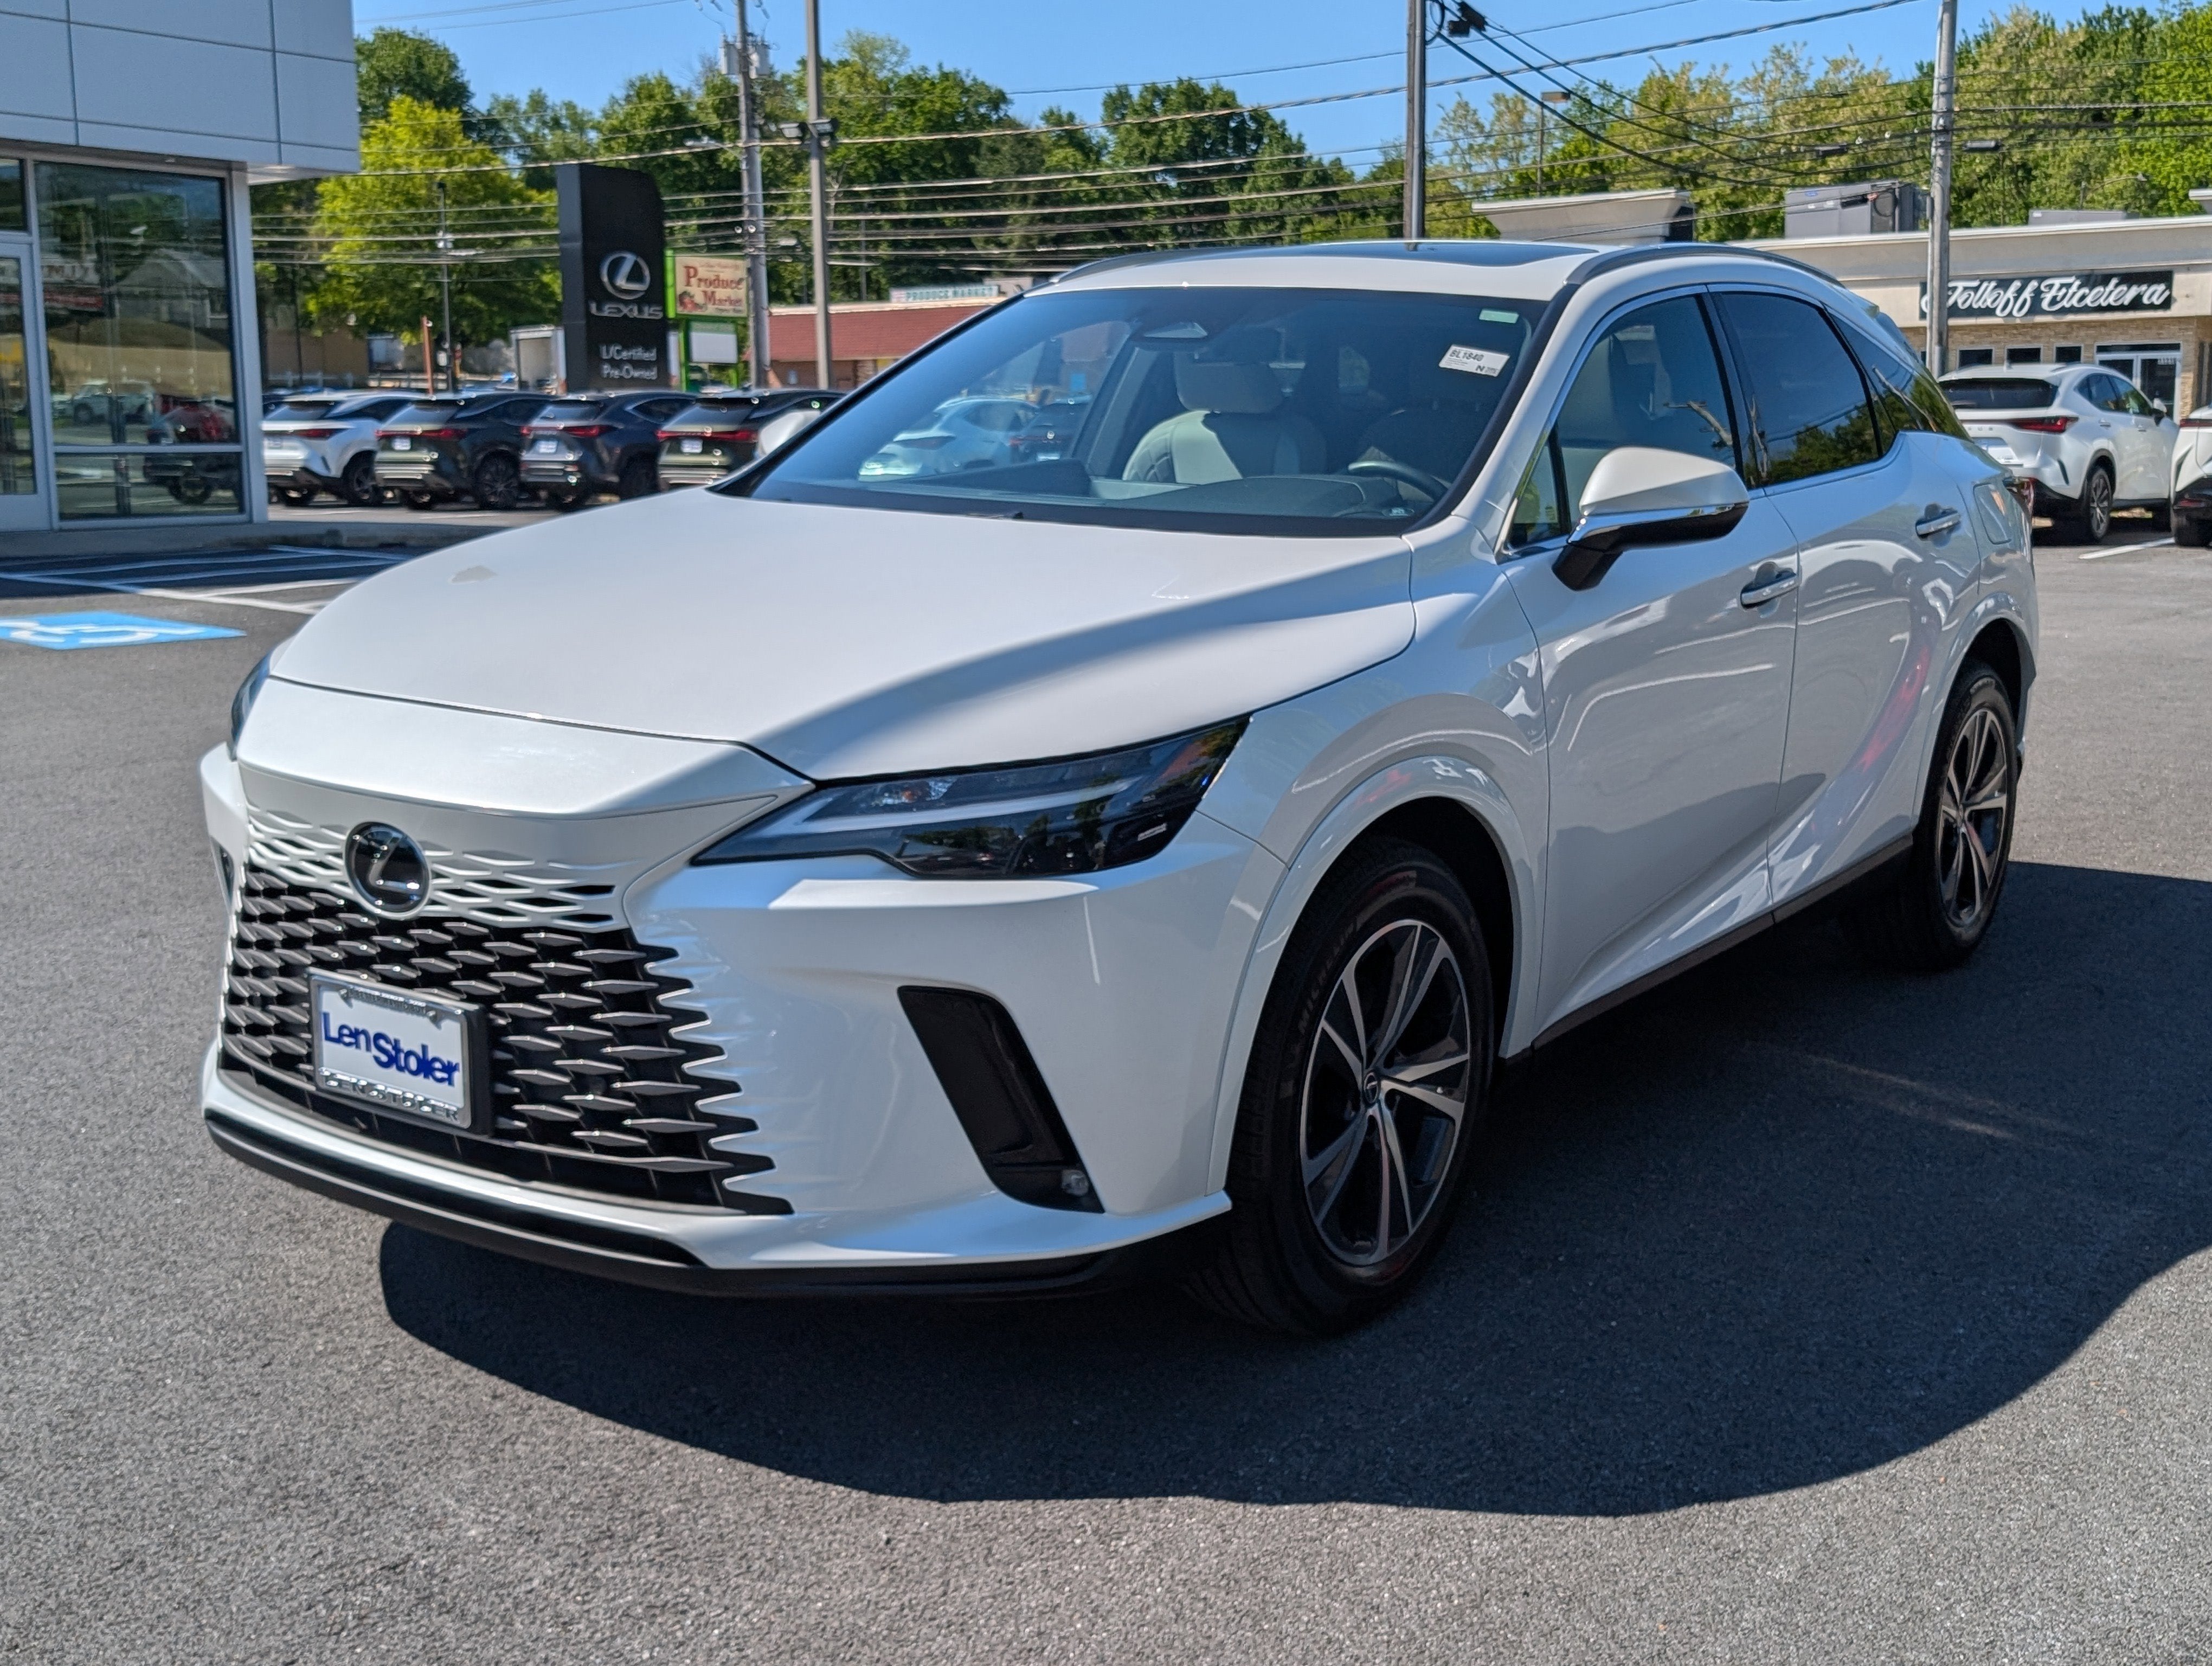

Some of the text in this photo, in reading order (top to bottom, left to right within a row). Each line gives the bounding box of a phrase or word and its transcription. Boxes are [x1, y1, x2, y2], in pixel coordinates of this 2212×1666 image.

[683, 266, 744, 290] Produce
[701, 290, 742, 306] Market
[2040, 275, 2170, 311] Etcetera
[589, 301, 663, 319] LEXUS
[601, 362, 658, 380] Pre-Owned
[1298, 922, 1354, 1035] MICHELIN
